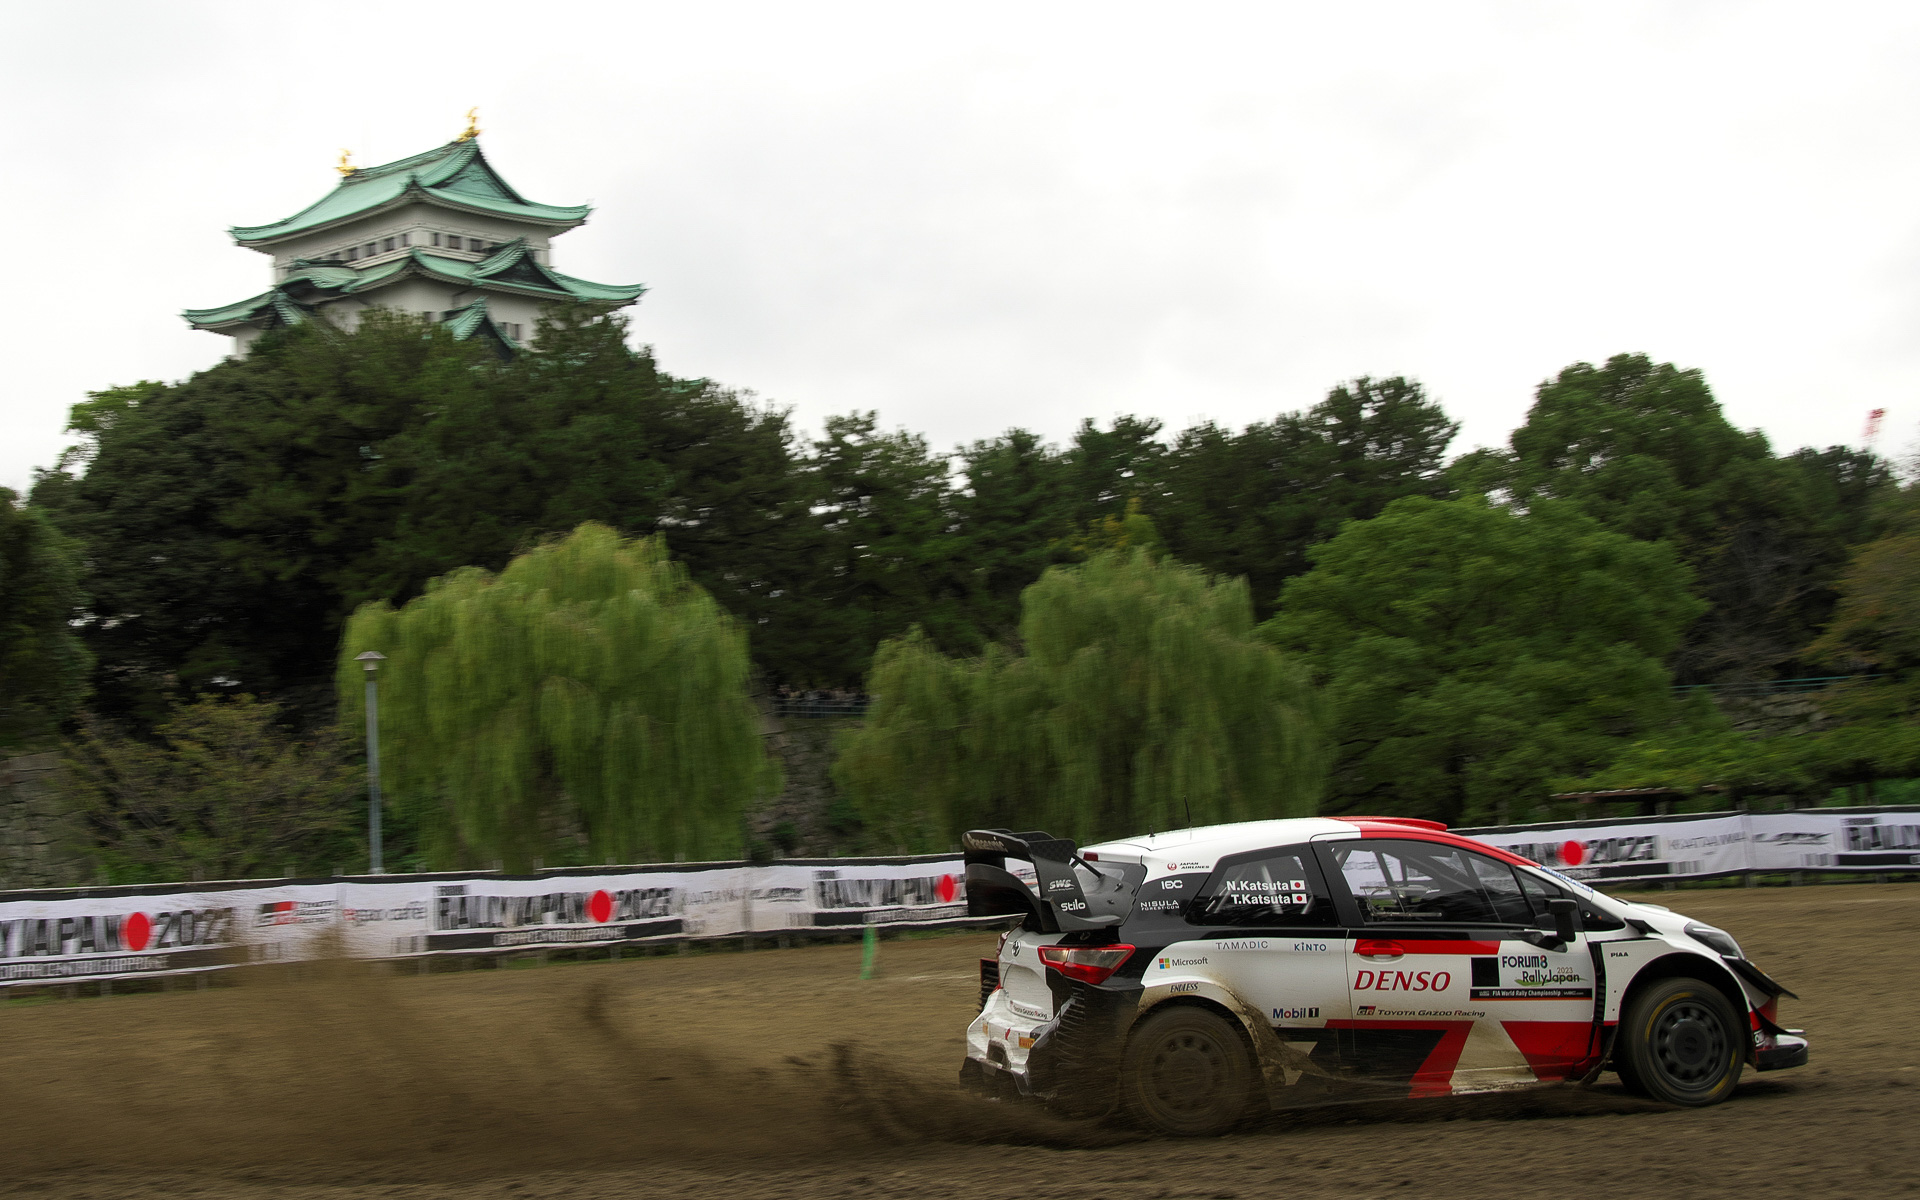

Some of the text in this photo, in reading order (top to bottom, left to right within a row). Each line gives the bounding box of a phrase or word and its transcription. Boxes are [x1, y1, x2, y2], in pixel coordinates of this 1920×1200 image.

[1226, 880, 1289, 891] N.Katsuta
[1140, 900, 1179, 908] NISULA
[1230, 893, 1291, 904] T.Katsuta
[1215, 941, 1269, 950] TAMADIC
[1172, 957, 1208, 967] Microsoft
[1502, 955, 1548, 968] FORUM8
[1353, 970, 1451, 992] DENSO
[1170, 982, 1199, 993] ENDLESS
[1528, 989, 1561, 997] Championship
[1273, 1008, 1306, 1019] Mobil
[1453, 1009, 1485, 1018] Racing
